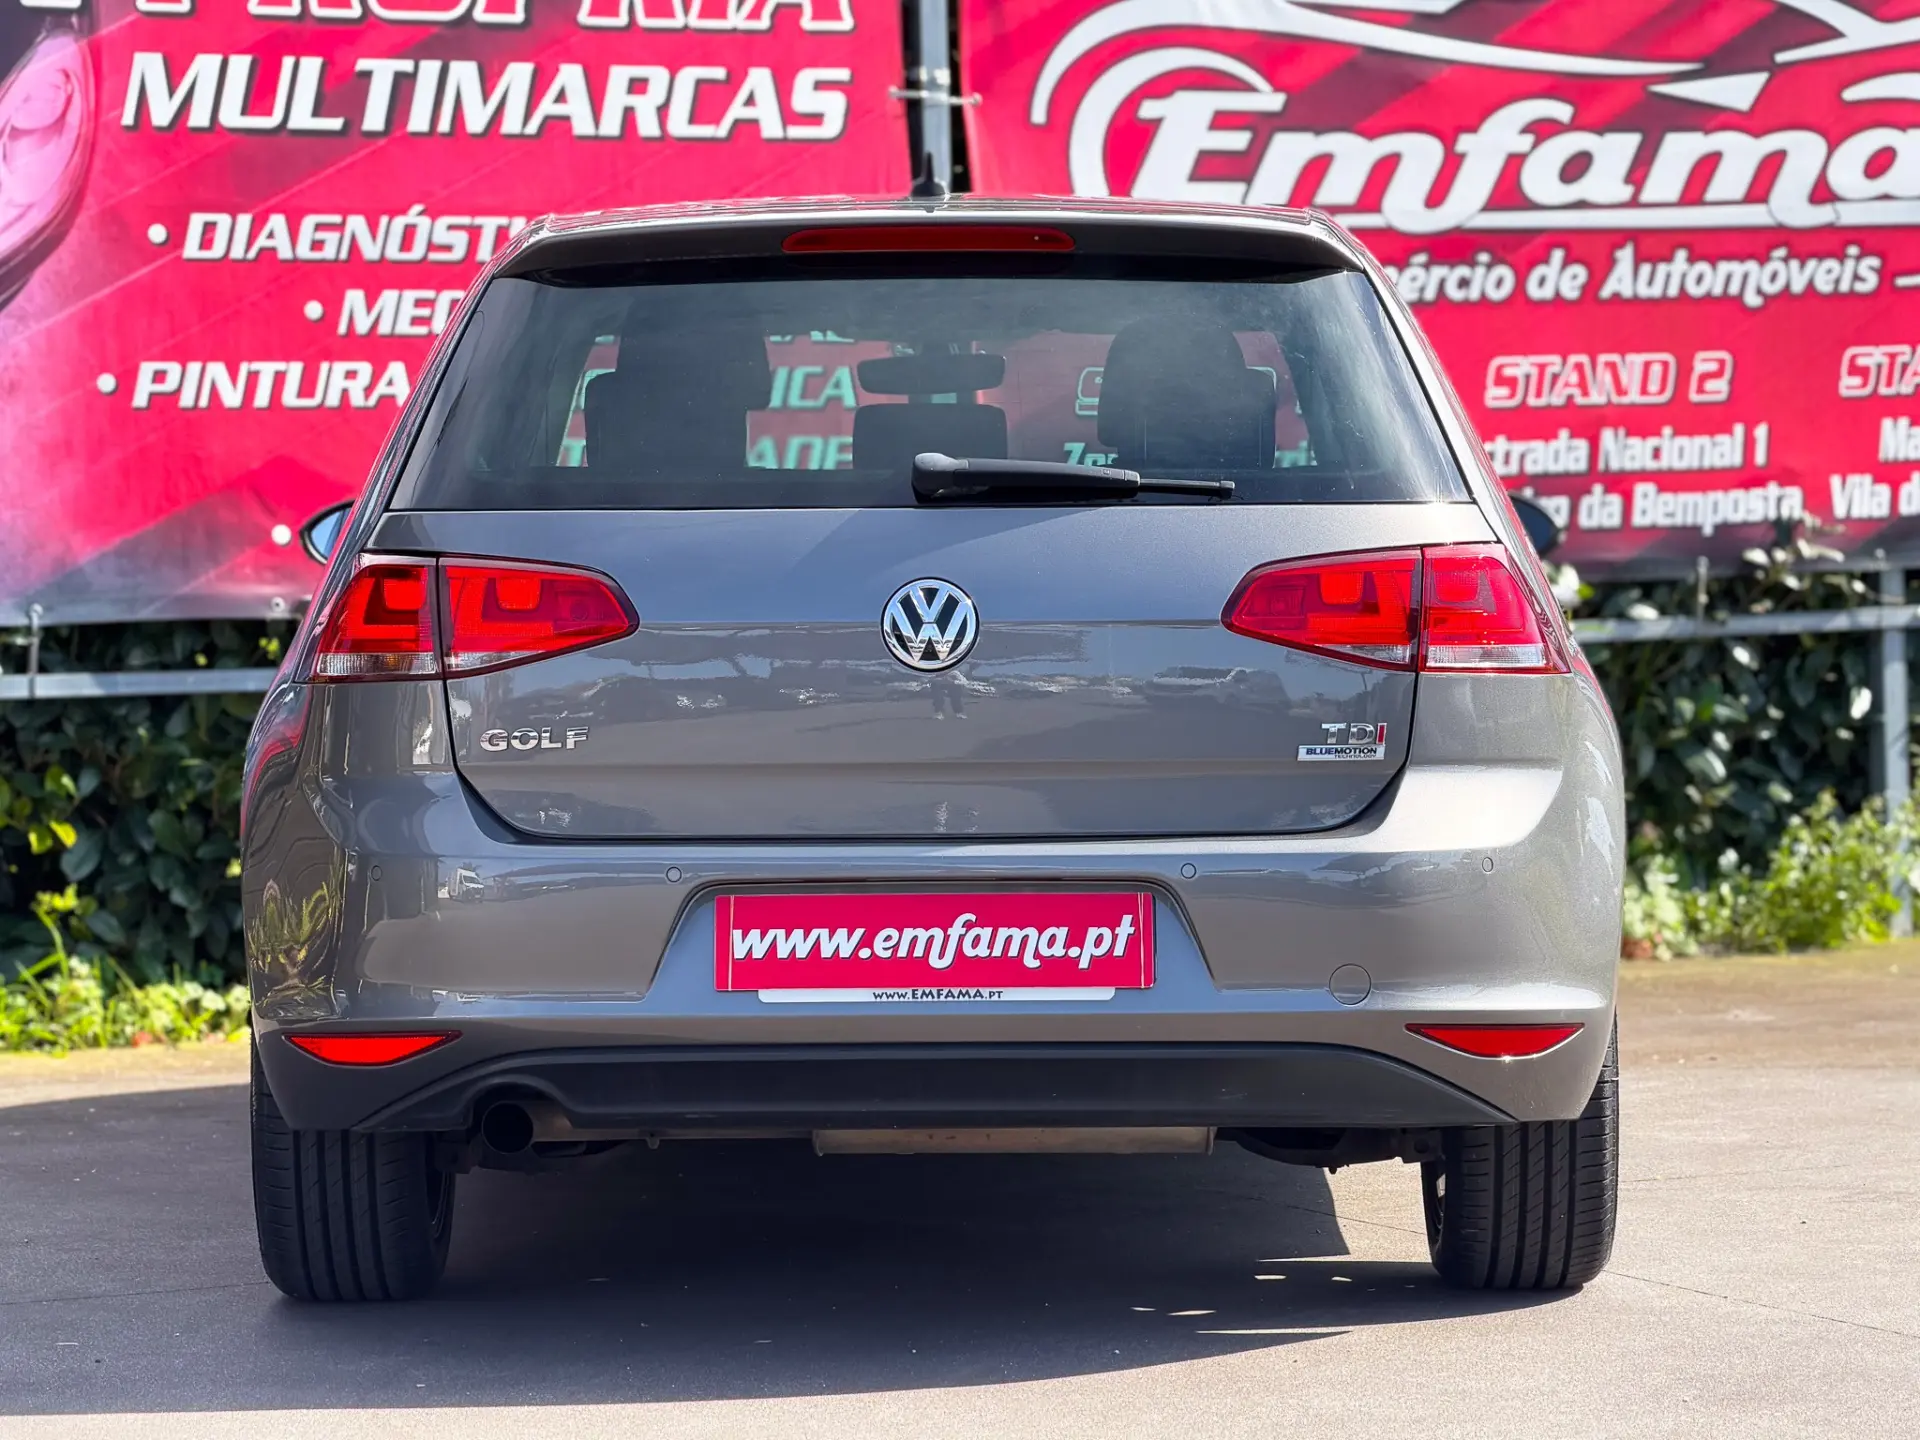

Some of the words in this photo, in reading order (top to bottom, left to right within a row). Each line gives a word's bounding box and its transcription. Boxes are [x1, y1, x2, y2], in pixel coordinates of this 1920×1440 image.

[121, 52, 851, 140] MULTIMARCAS
[1131, 90, 1920, 234] Emfama
[1525, 247, 1589, 302] de
[1601, 240, 1882, 307] Automóveis
[132, 361, 411, 409] PINTURA
[1484, 353, 1676, 408] STAND
[1689, 350, 1733, 403] 2
[1598, 422, 1746, 473] Nacional
[1753, 422, 1770, 468] 1
[1577, 483, 1624, 530] da
[1631, 480, 1803, 536] Bemposta
[1829, 473, 1891, 519] Vila
[479, 726, 590, 751] GOLF
[1305, 747, 1378, 755] BLUEMOTION
[1321, 723, 1387, 745] TDI
[732, 912, 1136, 970] www.emfama.pt
